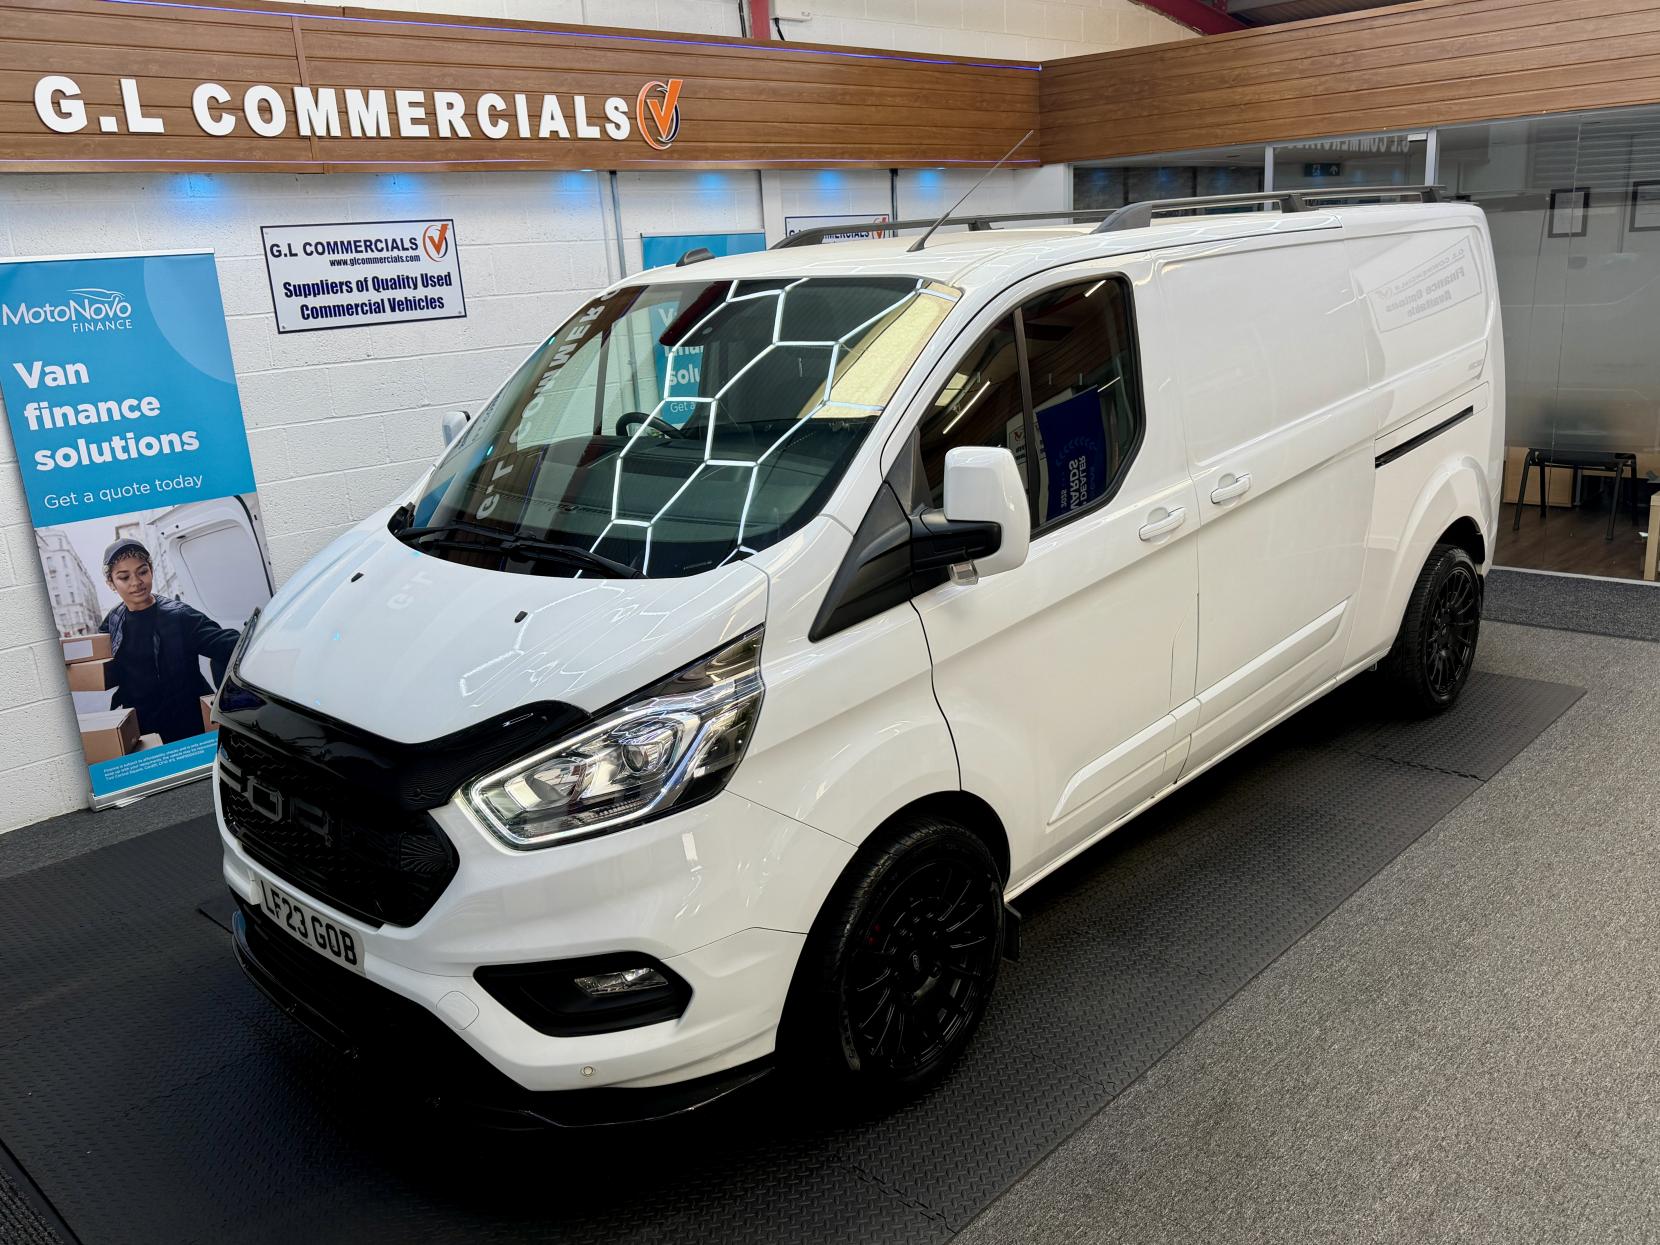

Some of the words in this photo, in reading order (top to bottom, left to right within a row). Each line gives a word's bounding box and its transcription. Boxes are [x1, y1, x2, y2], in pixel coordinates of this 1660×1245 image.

[34, 75, 164, 133] G.L
[192, 82, 630, 141] COMMERCIALS
[270, 242, 298, 258] G.L
[303, 237, 418, 256] COMMERCIALS
[329, 254, 421, 267] www.glcommercials.com
[283, 279, 353, 298] Suppliers
[356, 277, 369, 292] of
[372, 274, 418, 292] Quality
[420, 272, 452, 288] Used
[2, 298, 132, 326] MotoNovo
[300, 299, 385, 321] Commercial
[388, 296, 444, 313] Vehicles
[72, 319, 133, 333] FINANCE
[13, 361, 90, 389] Van
[24, 396, 161, 431] finance
[34, 430, 200, 471] solutions
[44, 493, 78, 509] Get
[83, 492, 94, 503] a
[99, 481, 151, 501] quote
[155, 474, 203, 493] today
[261, 879, 308, 939] LF23
[311, 915, 357, 966] GOB
